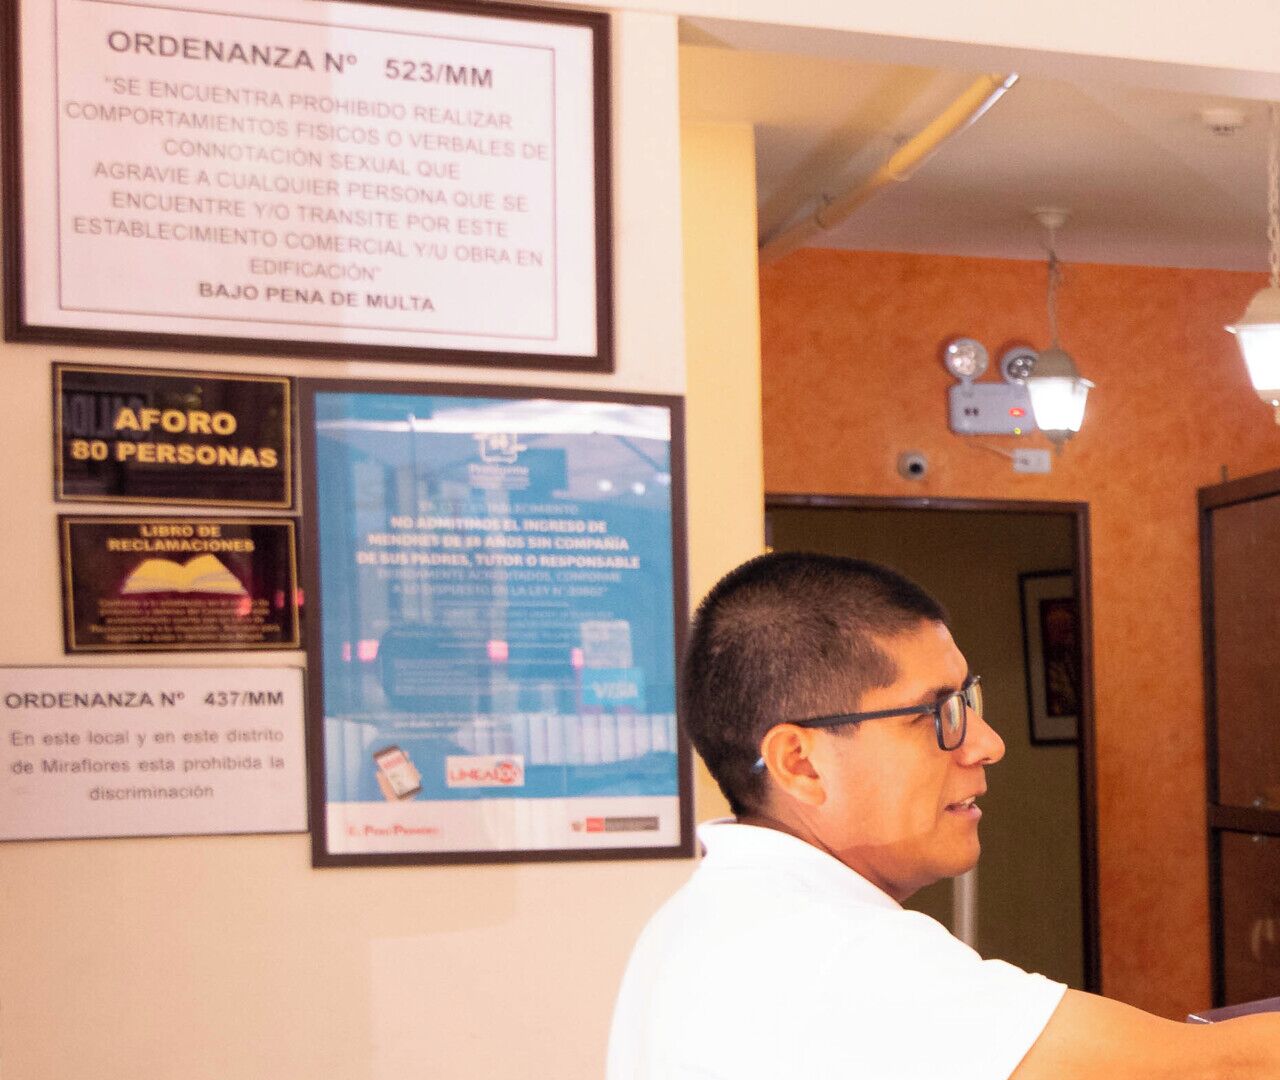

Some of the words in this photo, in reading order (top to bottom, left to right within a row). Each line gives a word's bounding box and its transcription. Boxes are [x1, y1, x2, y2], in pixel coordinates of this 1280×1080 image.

[107, 30, 314, 71] ORDENANZA
[385, 59, 494, 89] 523/MM
[150, 80, 283, 108] ENCUENTRA
[290, 93, 406, 119] PROHIBIDO
[414, 105, 513, 129] REALIZAR
[65, 101, 289, 137] COMPORTAMIENTOS
[388, 132, 402, 147] O
[409, 134, 515, 158] VERBALES
[522, 144, 549, 160] DE
[330, 152, 410, 176] SEXUAL
[417, 161, 460, 181] QUE
[95, 162, 187, 185] AGRAVIE
[197, 171, 210, 187] A
[216, 170, 341, 196] CUALQUIER
[347, 181, 447, 205] PERSONA
[453, 190, 496, 210] QUE
[502, 195, 528, 212] SE
[111, 192, 245, 218] ENCUENTRE
[254, 201, 290, 221] Y/O
[298, 206, 399, 230] TRANSITE
[406, 215, 451, 234] POR
[457, 219, 509, 237] ESTE
[74, 217, 278, 248] ESTABLECIMIENTO
[284, 231, 408, 257] COMERCIAL
[455, 245, 510, 264] OBRA
[516, 250, 543, 266] EN
[198, 282, 259, 301] BAJO
[266, 287, 325, 305] PENA
[332, 291, 359, 307] DE
[366, 293, 435, 312] MULTA
[114, 408, 237, 435] AFORO
[72, 443, 108, 461] 80
[116, 444, 278, 468] PERSONAS
[107, 537, 255, 553] RECLAMACIONES
[141, 524, 193, 537] LIBRO
[199, 525, 220, 538] DE
[6, 693, 154, 709] ORDENANZA
[204, 690, 284, 707] 437/MM
[10, 731, 34, 746] En
[42, 732, 80, 746] este
[88, 731, 129, 745] local
[138, 734, 145, 748] y
[154, 733, 175, 744] en
[183, 732, 219, 744] este
[227, 729, 284, 743] distrito
[10, 760, 34, 774] de
[42, 759, 130, 774] Miraflores
[138, 760, 176, 773] esta
[184, 757, 262, 775] prohibida
[270, 757, 284, 770] la
[90, 785, 215, 801] discriminación
